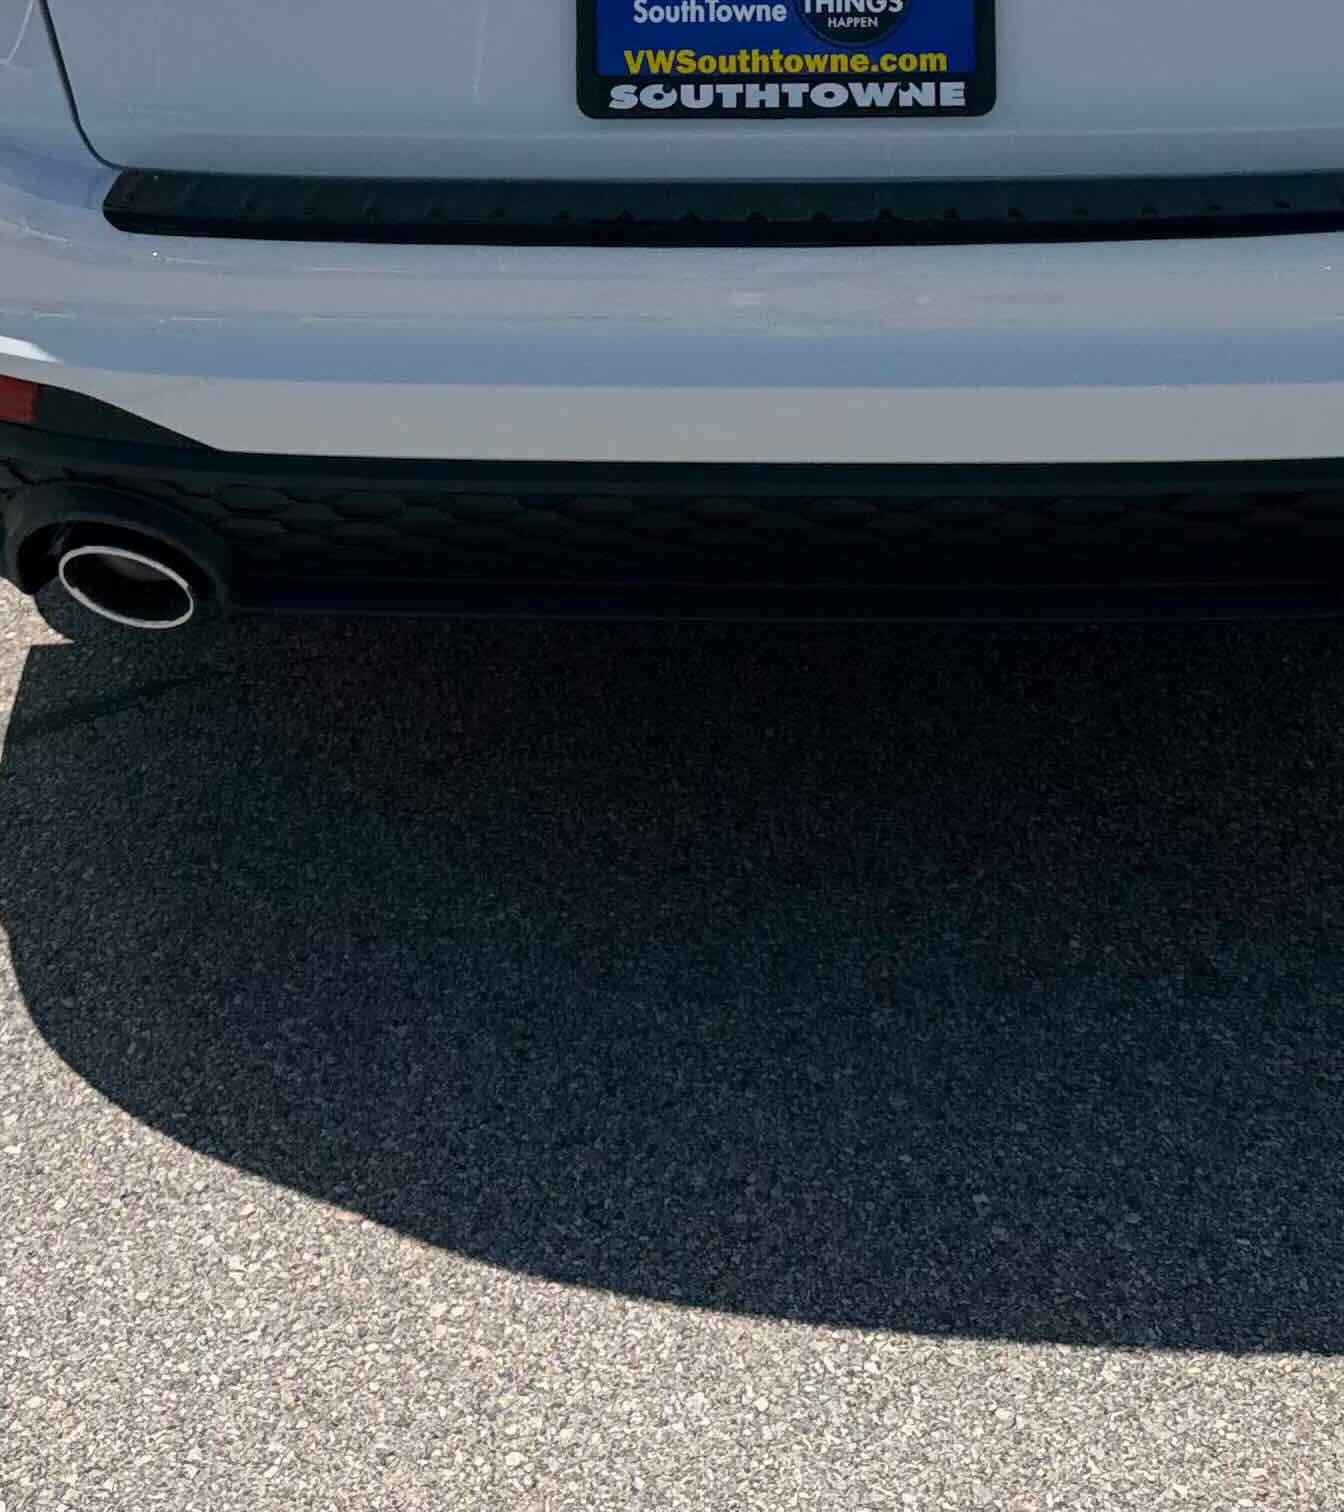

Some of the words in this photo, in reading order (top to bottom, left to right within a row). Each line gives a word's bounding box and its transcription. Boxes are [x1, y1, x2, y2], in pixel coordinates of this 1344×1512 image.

[827, 16, 879, 29] HAPPEN
[623, 48, 948, 74] VWSouthtowne.com
[608, 81, 967, 110] SOUTHTOWNE
